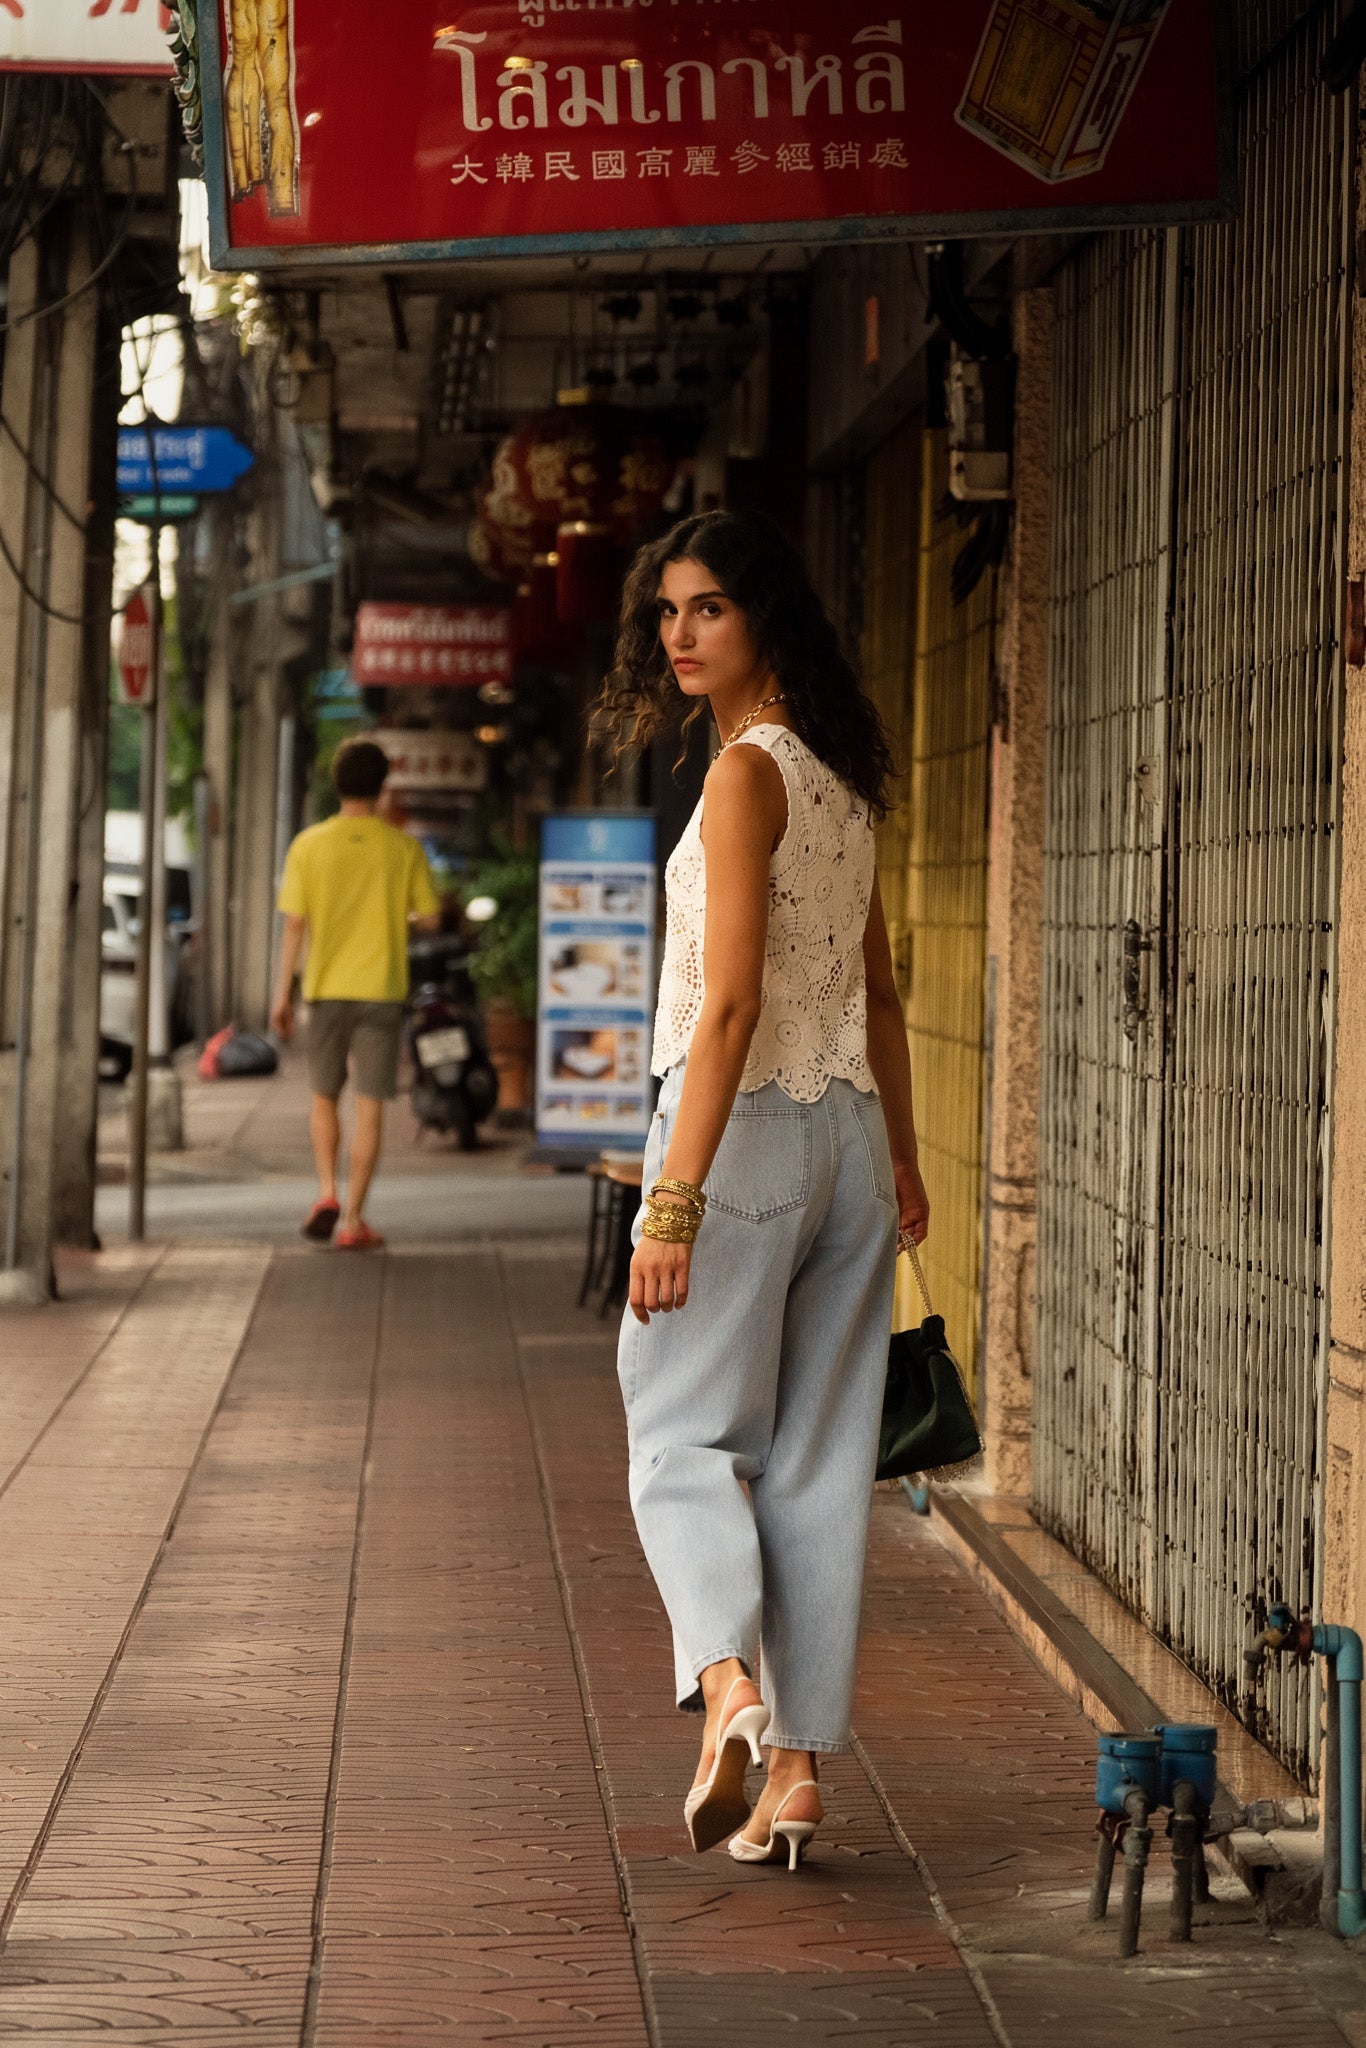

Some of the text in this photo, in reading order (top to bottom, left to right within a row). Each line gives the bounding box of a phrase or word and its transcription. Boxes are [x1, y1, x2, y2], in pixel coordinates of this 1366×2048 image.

[433, 19, 907, 132] โสมเกาหลี
[450, 137, 910, 185] 大韓民國高麗參經銷處
